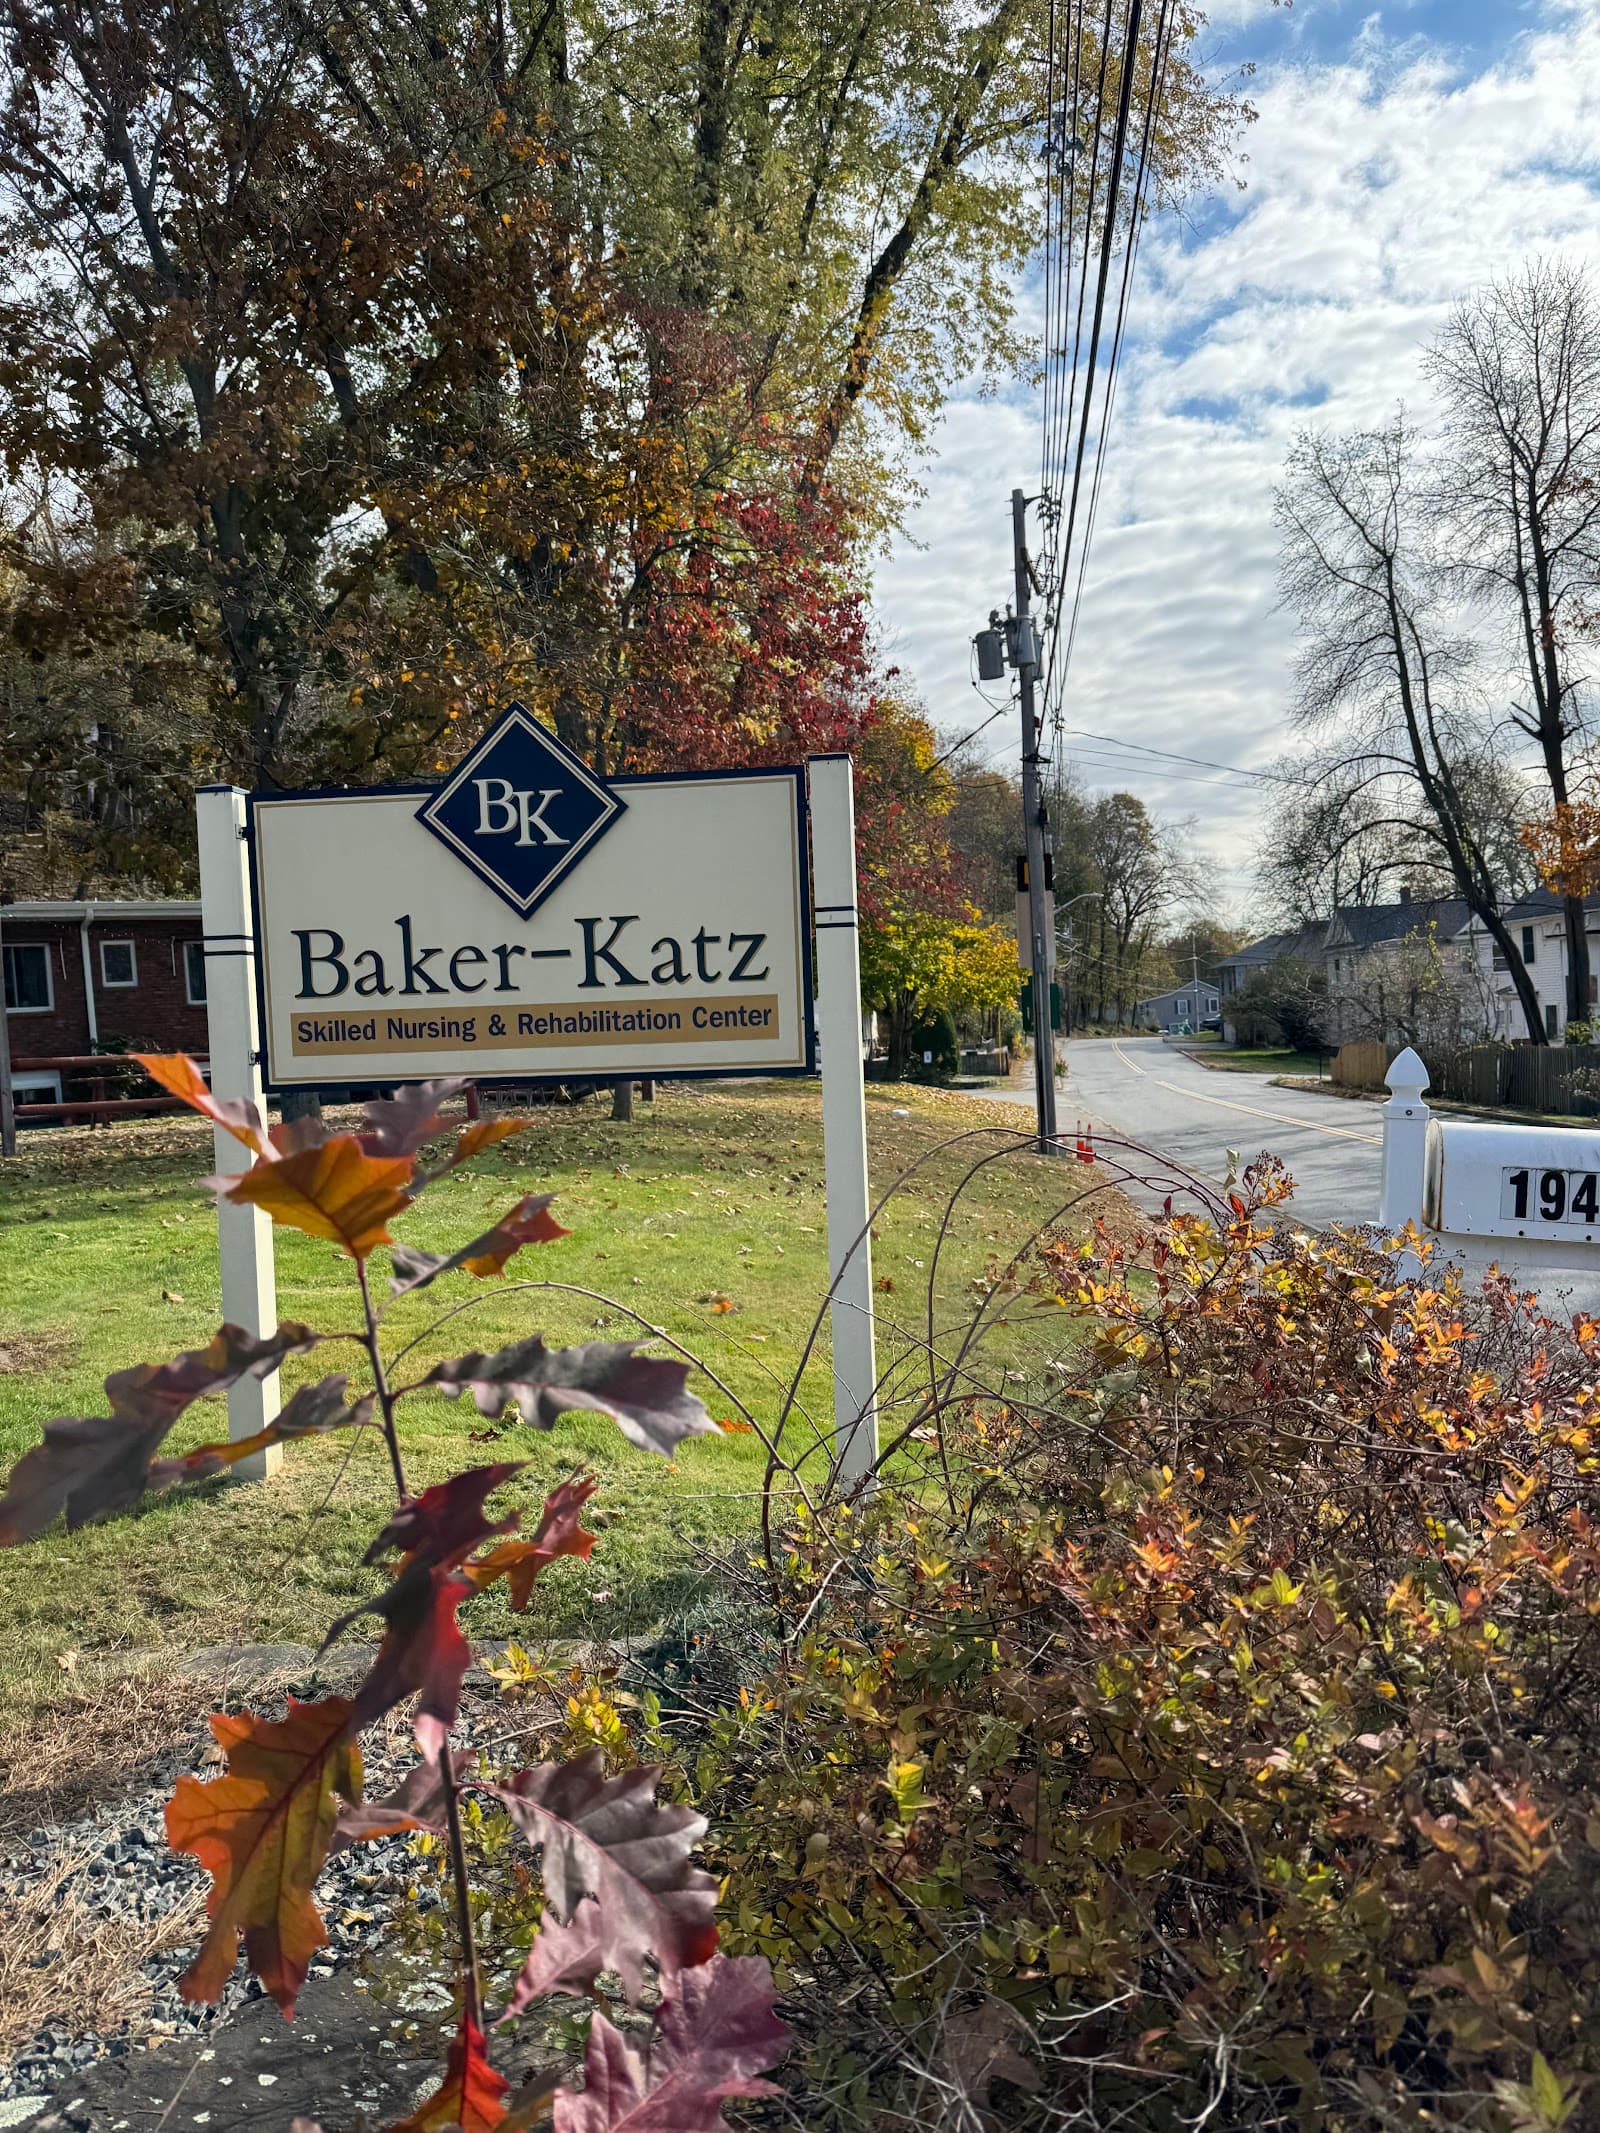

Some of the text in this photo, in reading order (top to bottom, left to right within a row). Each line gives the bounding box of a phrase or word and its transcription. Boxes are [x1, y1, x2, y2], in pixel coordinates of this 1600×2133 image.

[472, 778, 571, 846] BK
[290, 914, 771, 998] Baker-Katz
[297, 1005, 772, 1043] Skilled Nursing & Rehabilitation Center
[1509, 1169, 1599, 1222] 194
